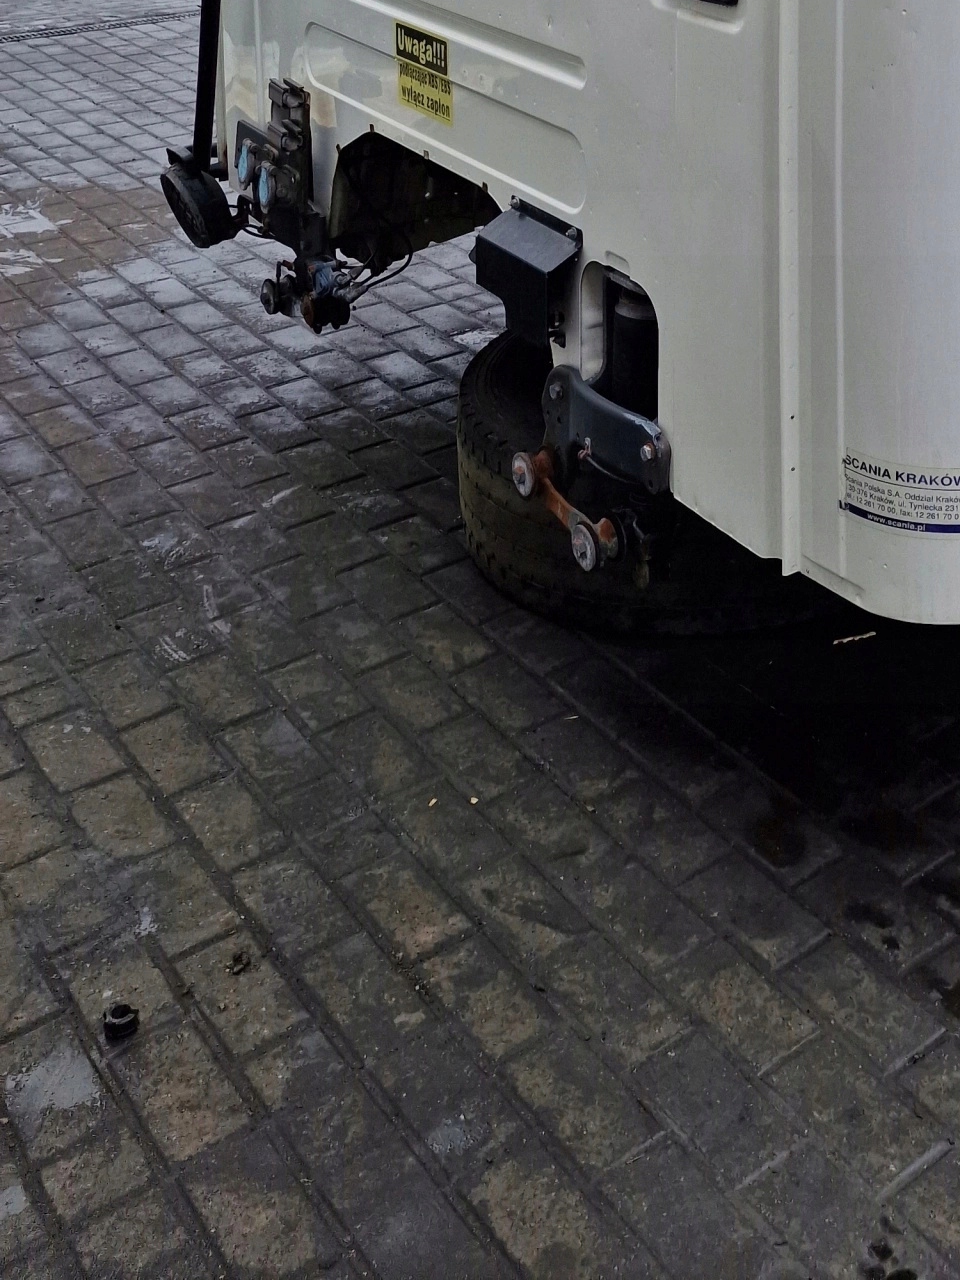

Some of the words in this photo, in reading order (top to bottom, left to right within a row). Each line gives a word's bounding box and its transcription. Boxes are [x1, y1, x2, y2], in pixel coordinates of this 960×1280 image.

[398, 27, 445, 68] Uwaga!!!
[842, 454, 891, 479] SCANIA
[864, 482, 885, 494] Polska
[887, 489, 901, 498] S.A.
[904, 492, 933, 502] Oddział
[870, 492, 896, 506] Kraków,
[897, 500, 906, 508] ul.
[909, 502, 942, 511] Tyniecka
[877, 503, 885, 511] 70
[915, 511, 924, 519] 12
[867, 513, 926, 533] www.scania.pl
